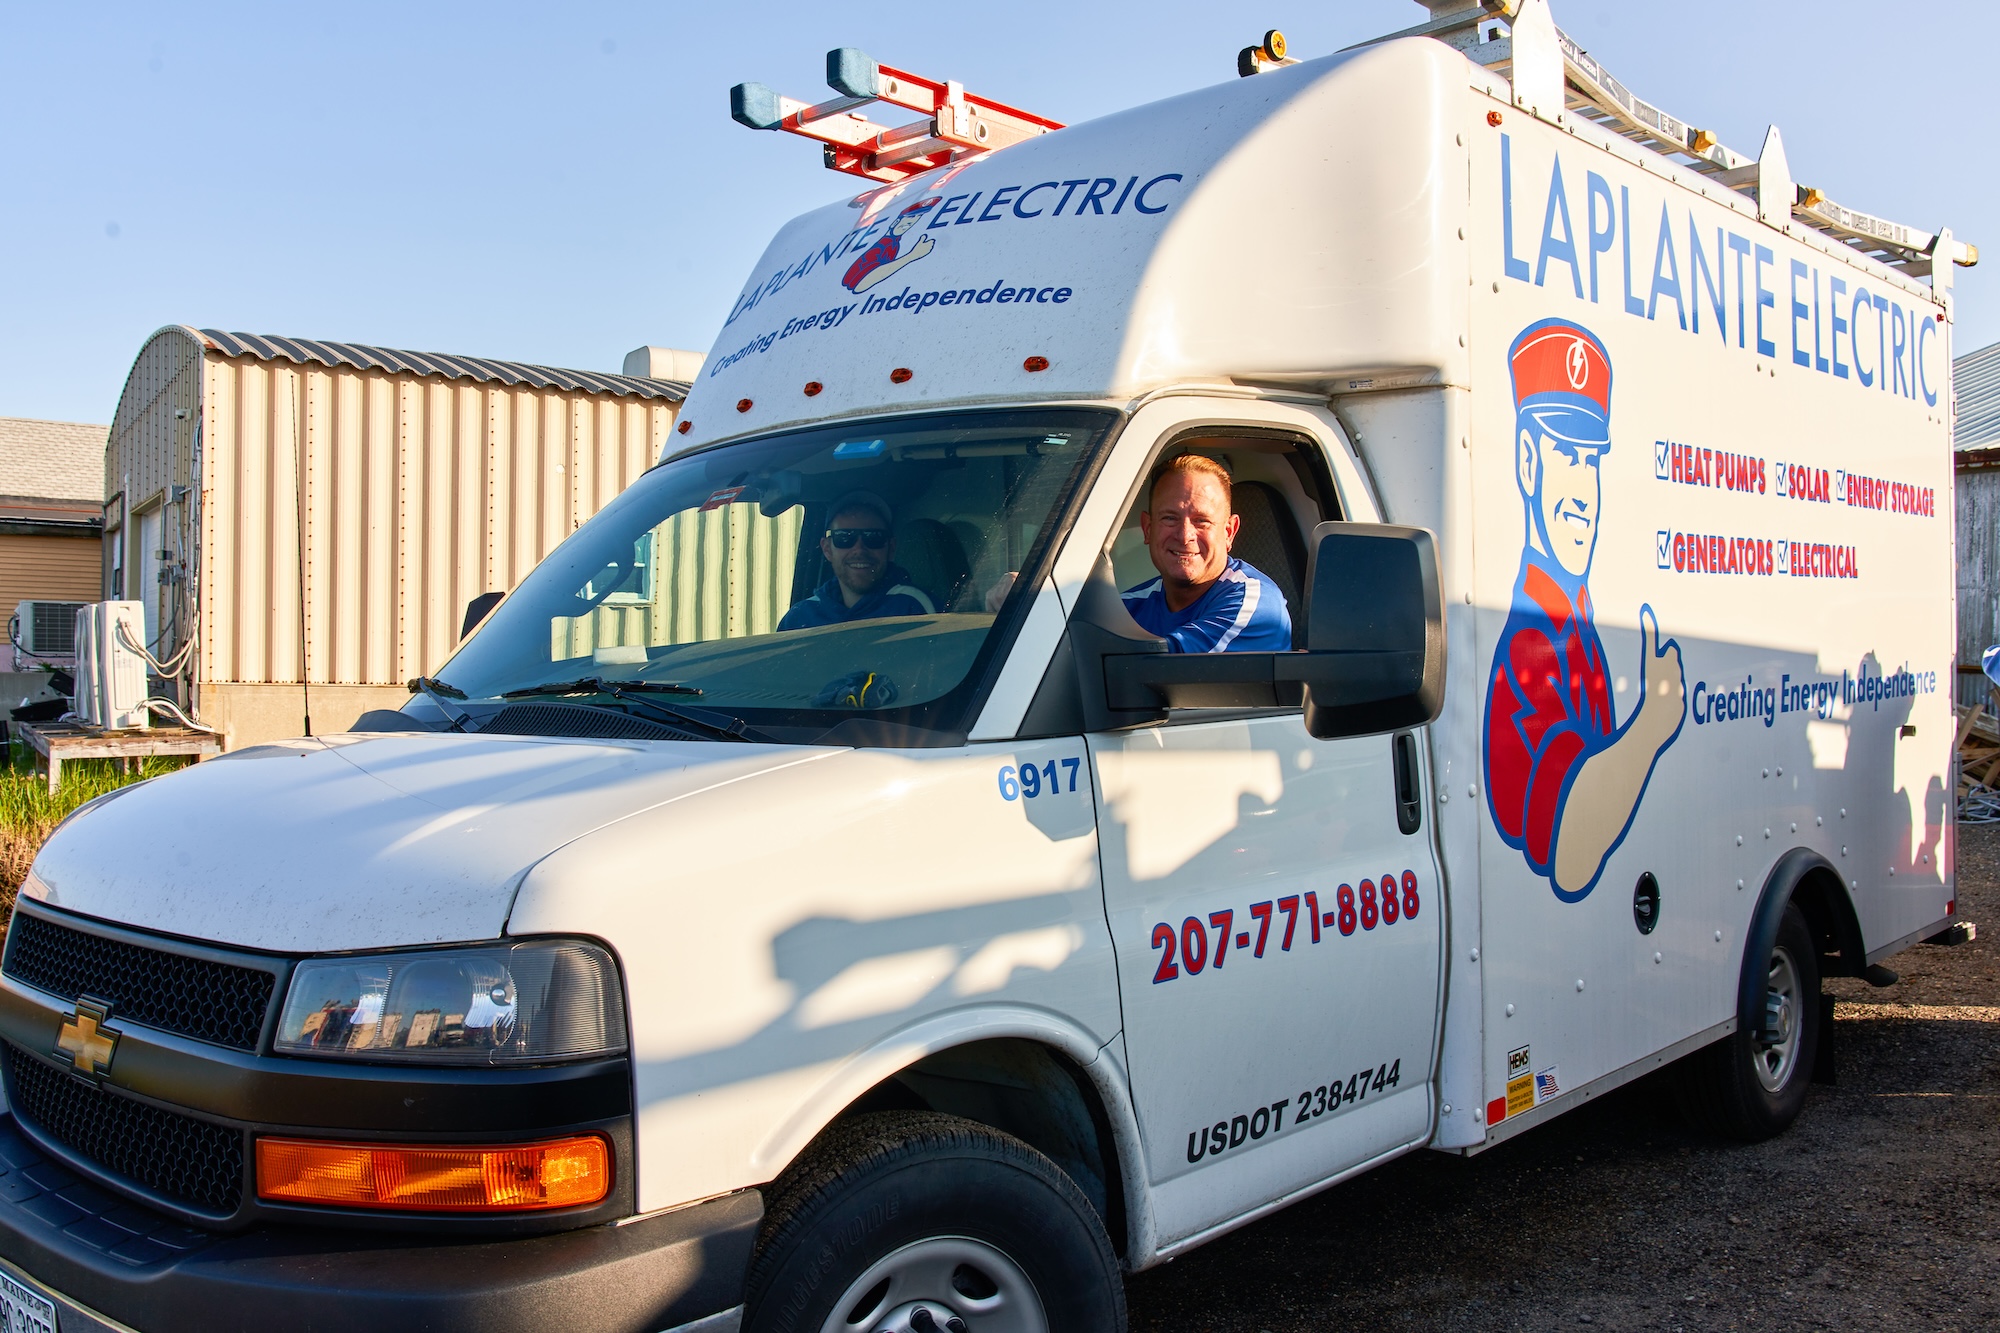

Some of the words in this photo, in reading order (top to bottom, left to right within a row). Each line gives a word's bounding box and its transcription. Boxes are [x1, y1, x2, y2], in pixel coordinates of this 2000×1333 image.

[724, 215, 887, 328] LAPLANTE
[926, 173, 1183, 230] ELECTRIC
[1501, 132, 1776, 359] LAPLANTE
[1790, 258, 1937, 407] ELECTRIC
[710, 329, 779, 378] Creating
[779, 302, 857, 341] Energy
[860, 280, 1073, 316] Independence
[1671, 442, 1712, 487] HEAT
[1715, 450, 1766, 495] PUMPS
[1788, 463, 1831, 503] SOLAR
[1847, 473, 1889, 511] ENERGY
[1891, 481, 1935, 517] STORAGE
[1673, 532, 1774, 576] GENERATORS
[1790, 542, 1858, 579] ELECTRICAL
[1692, 675, 1775, 728] Creating
[1780, 674, 1839, 720] Energy
[1842, 660, 1936, 711] Independence
[998, 757, 1080, 801] 6917
[1151, 869, 1420, 985] 207-771-8888
[1509, 1050, 1528, 1071] HEWS
[1509, 1078, 1531, 1093] WARNING
[1187, 1099, 1290, 1164] USDOT
[1294, 1058, 1400, 1125] 2384744
[2, 1279, 34, 1308] MAINE
